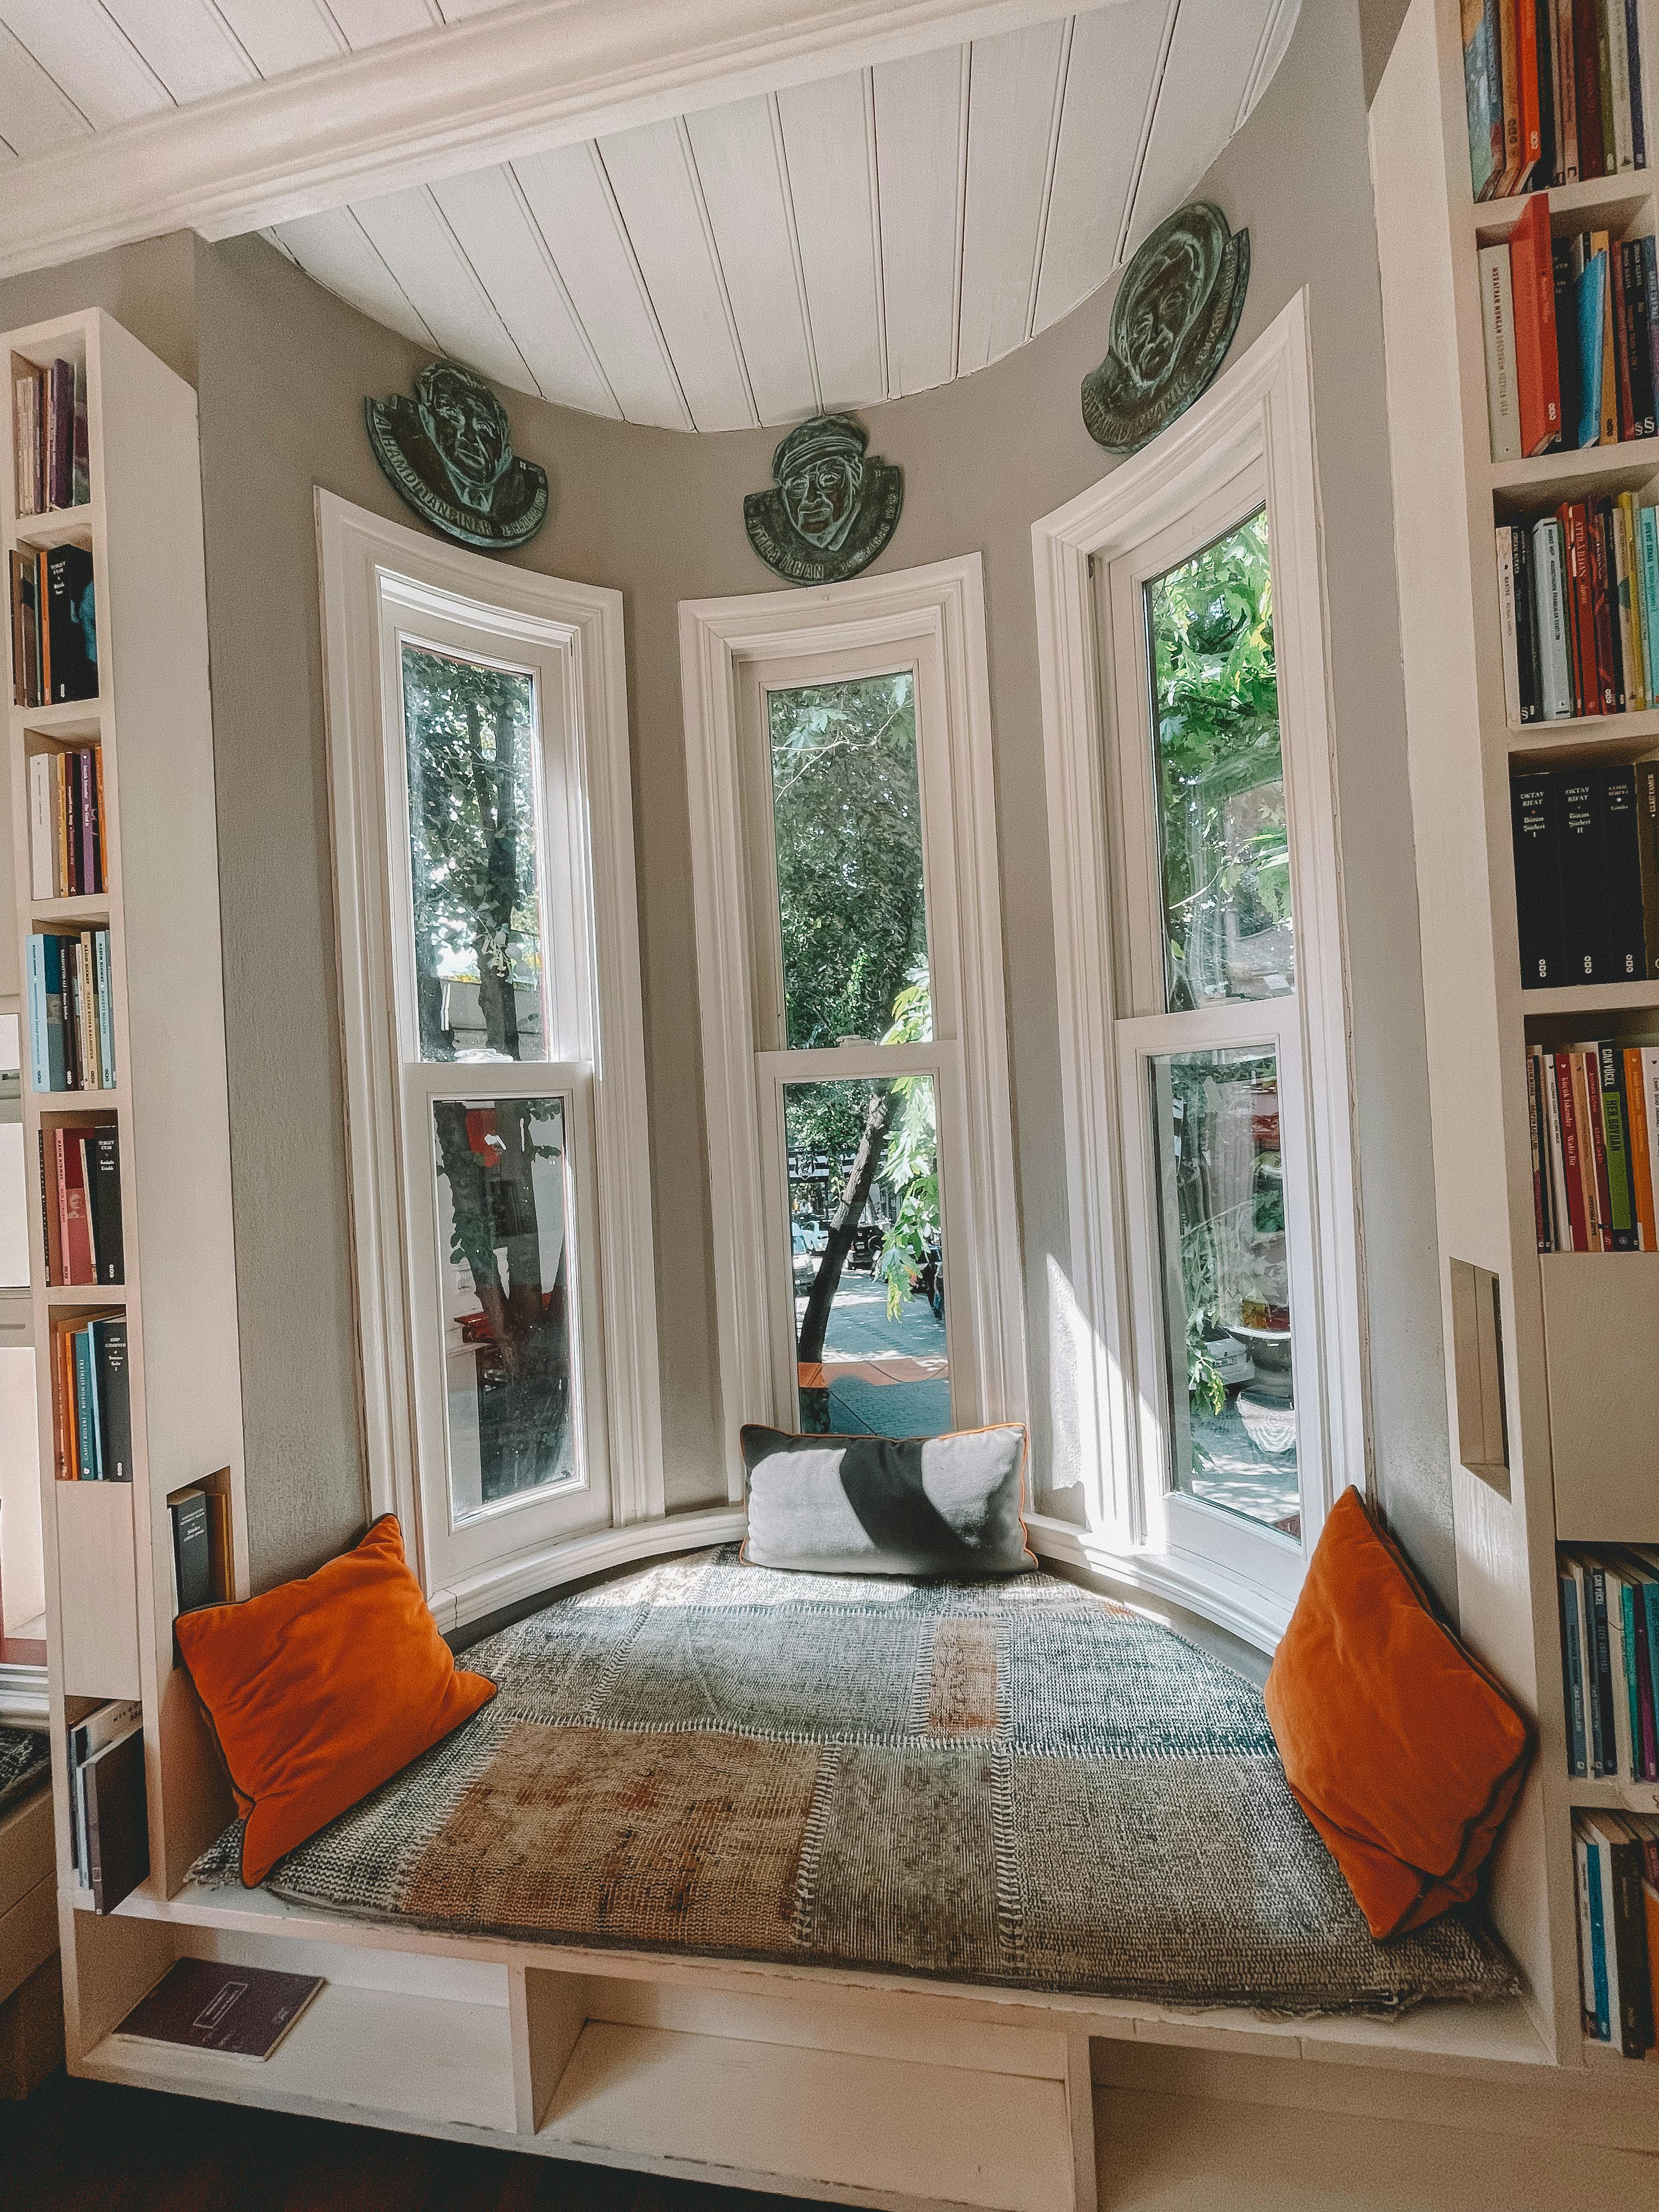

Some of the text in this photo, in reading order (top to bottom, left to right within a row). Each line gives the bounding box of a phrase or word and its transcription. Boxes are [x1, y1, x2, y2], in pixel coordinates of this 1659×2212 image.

[1492, 267, 1502, 304] MURATHAN
[1494, 306, 1503, 334] MUNGAN
[778, 552, 824, 579] İLHAN
[1520, 791, 1544, 799] OKTAY
[1601, 1049, 1615, 1086] CAN YÜCEL
[1561, 1077, 1571, 1098] küçük
[1563, 1099, 1572, 1127] İskender
[1606, 1099, 1621, 1152] HER BOYDAN
[1595, 1588, 1604, 1605] YÜCEL
